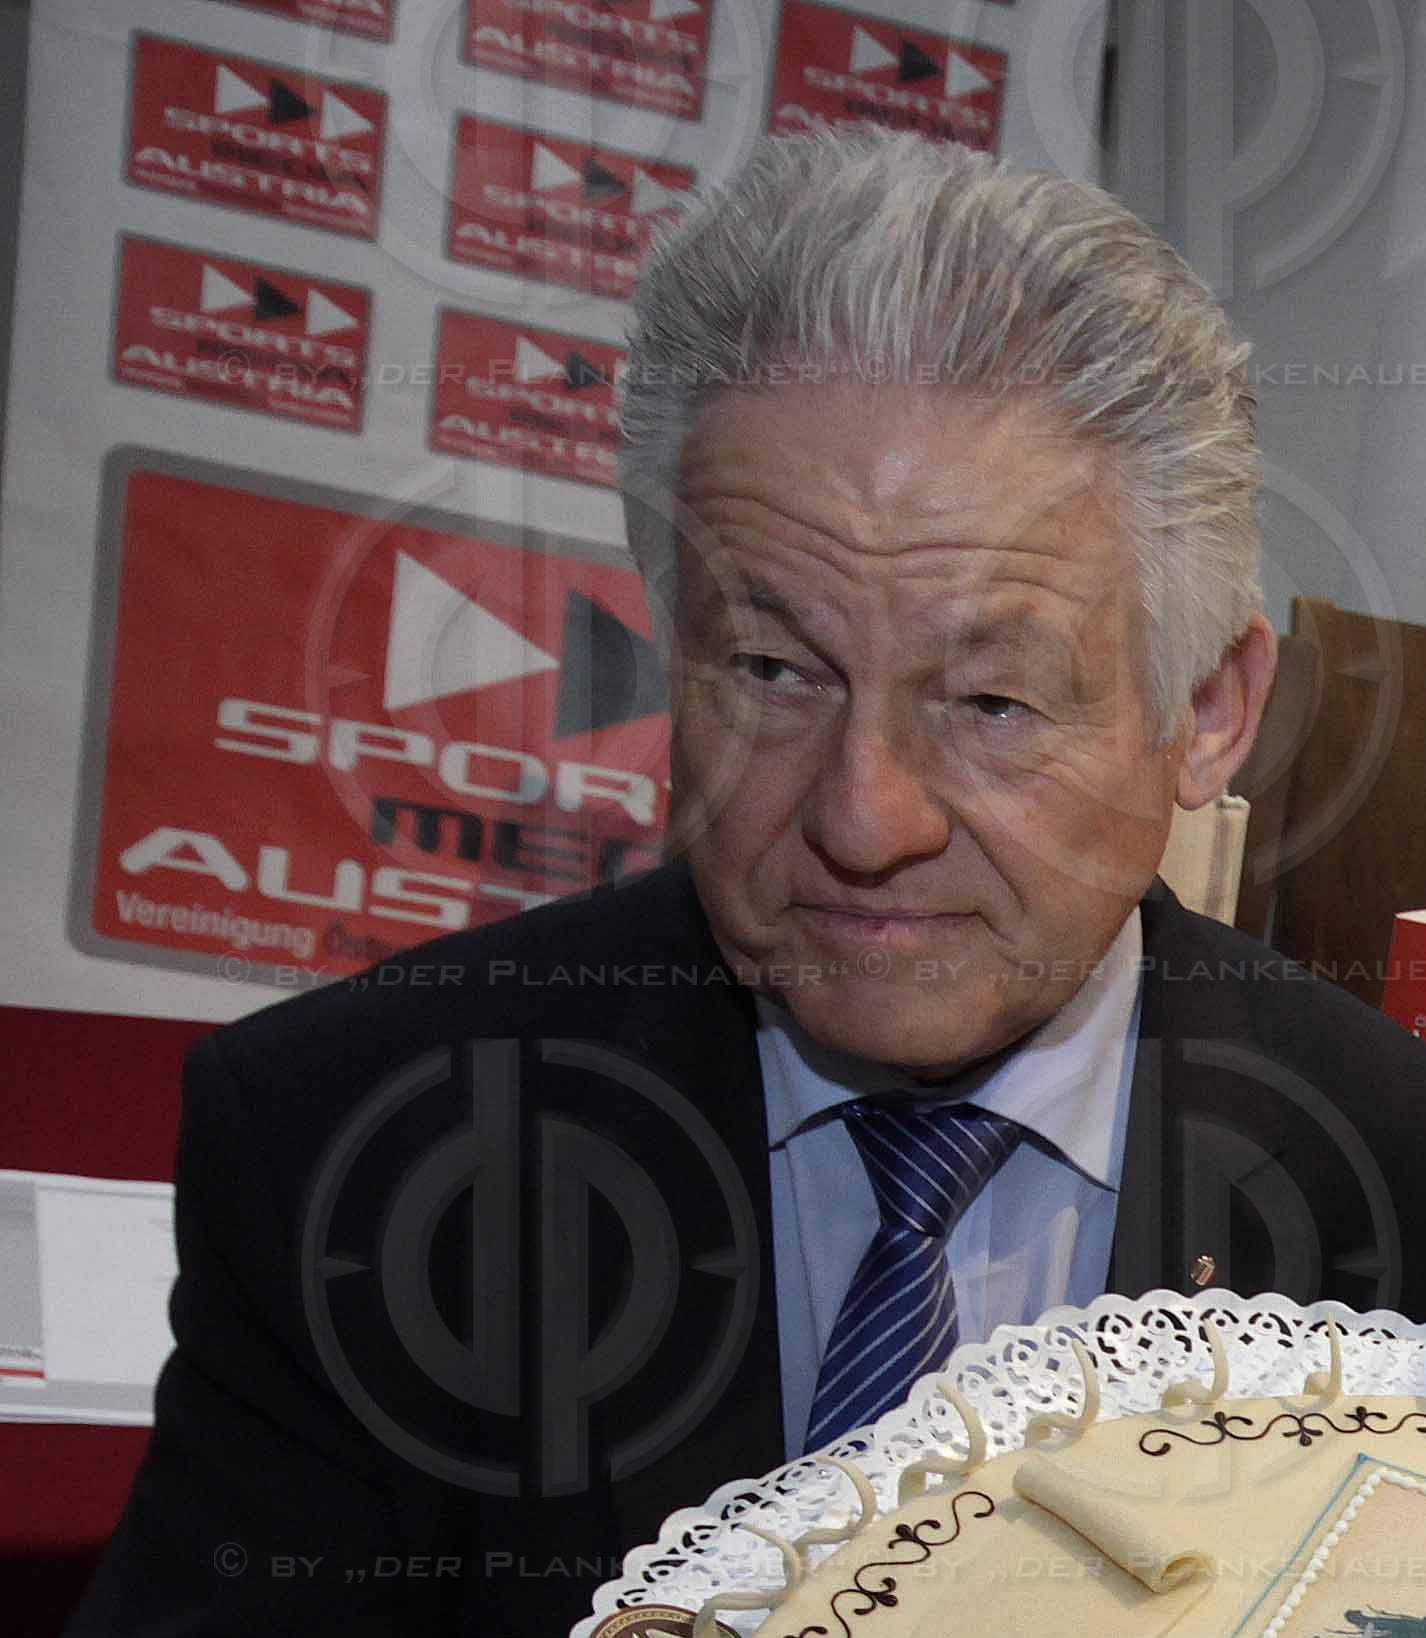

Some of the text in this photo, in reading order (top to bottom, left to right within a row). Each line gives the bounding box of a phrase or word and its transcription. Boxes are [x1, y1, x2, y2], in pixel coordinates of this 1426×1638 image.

[803, 65, 992, 129] SPORTS
[163, 105, 372, 173] SPORTS
[133, 146, 370, 214] AUSTRIA
[482, 184, 652, 240] SPORT
[150, 305, 355, 368] SPORTS
[121, 344, 355, 409] AUSTRIA
[214, 697, 672, 826] SPOR
[115, 889, 318, 960] Vereinigung
